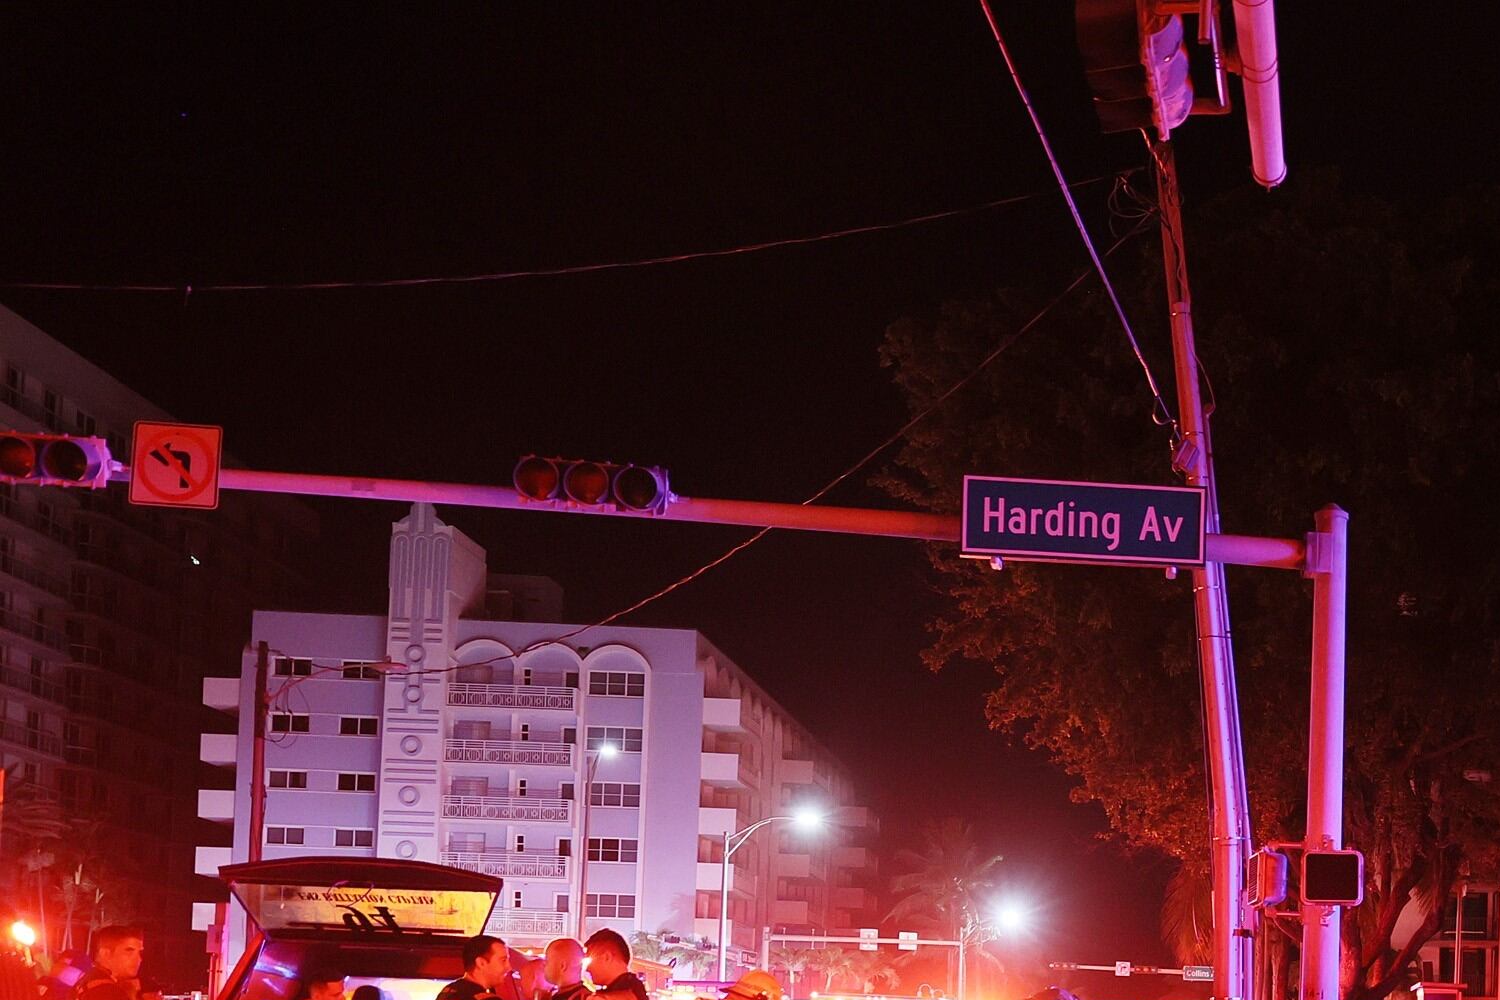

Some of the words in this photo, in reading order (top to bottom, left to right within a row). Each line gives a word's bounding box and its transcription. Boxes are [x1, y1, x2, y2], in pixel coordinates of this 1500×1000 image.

[983, 496, 1121, 551] Harding
[1138, 506, 1184, 543] Av
[1186, 969, 1210, 978] Collins
